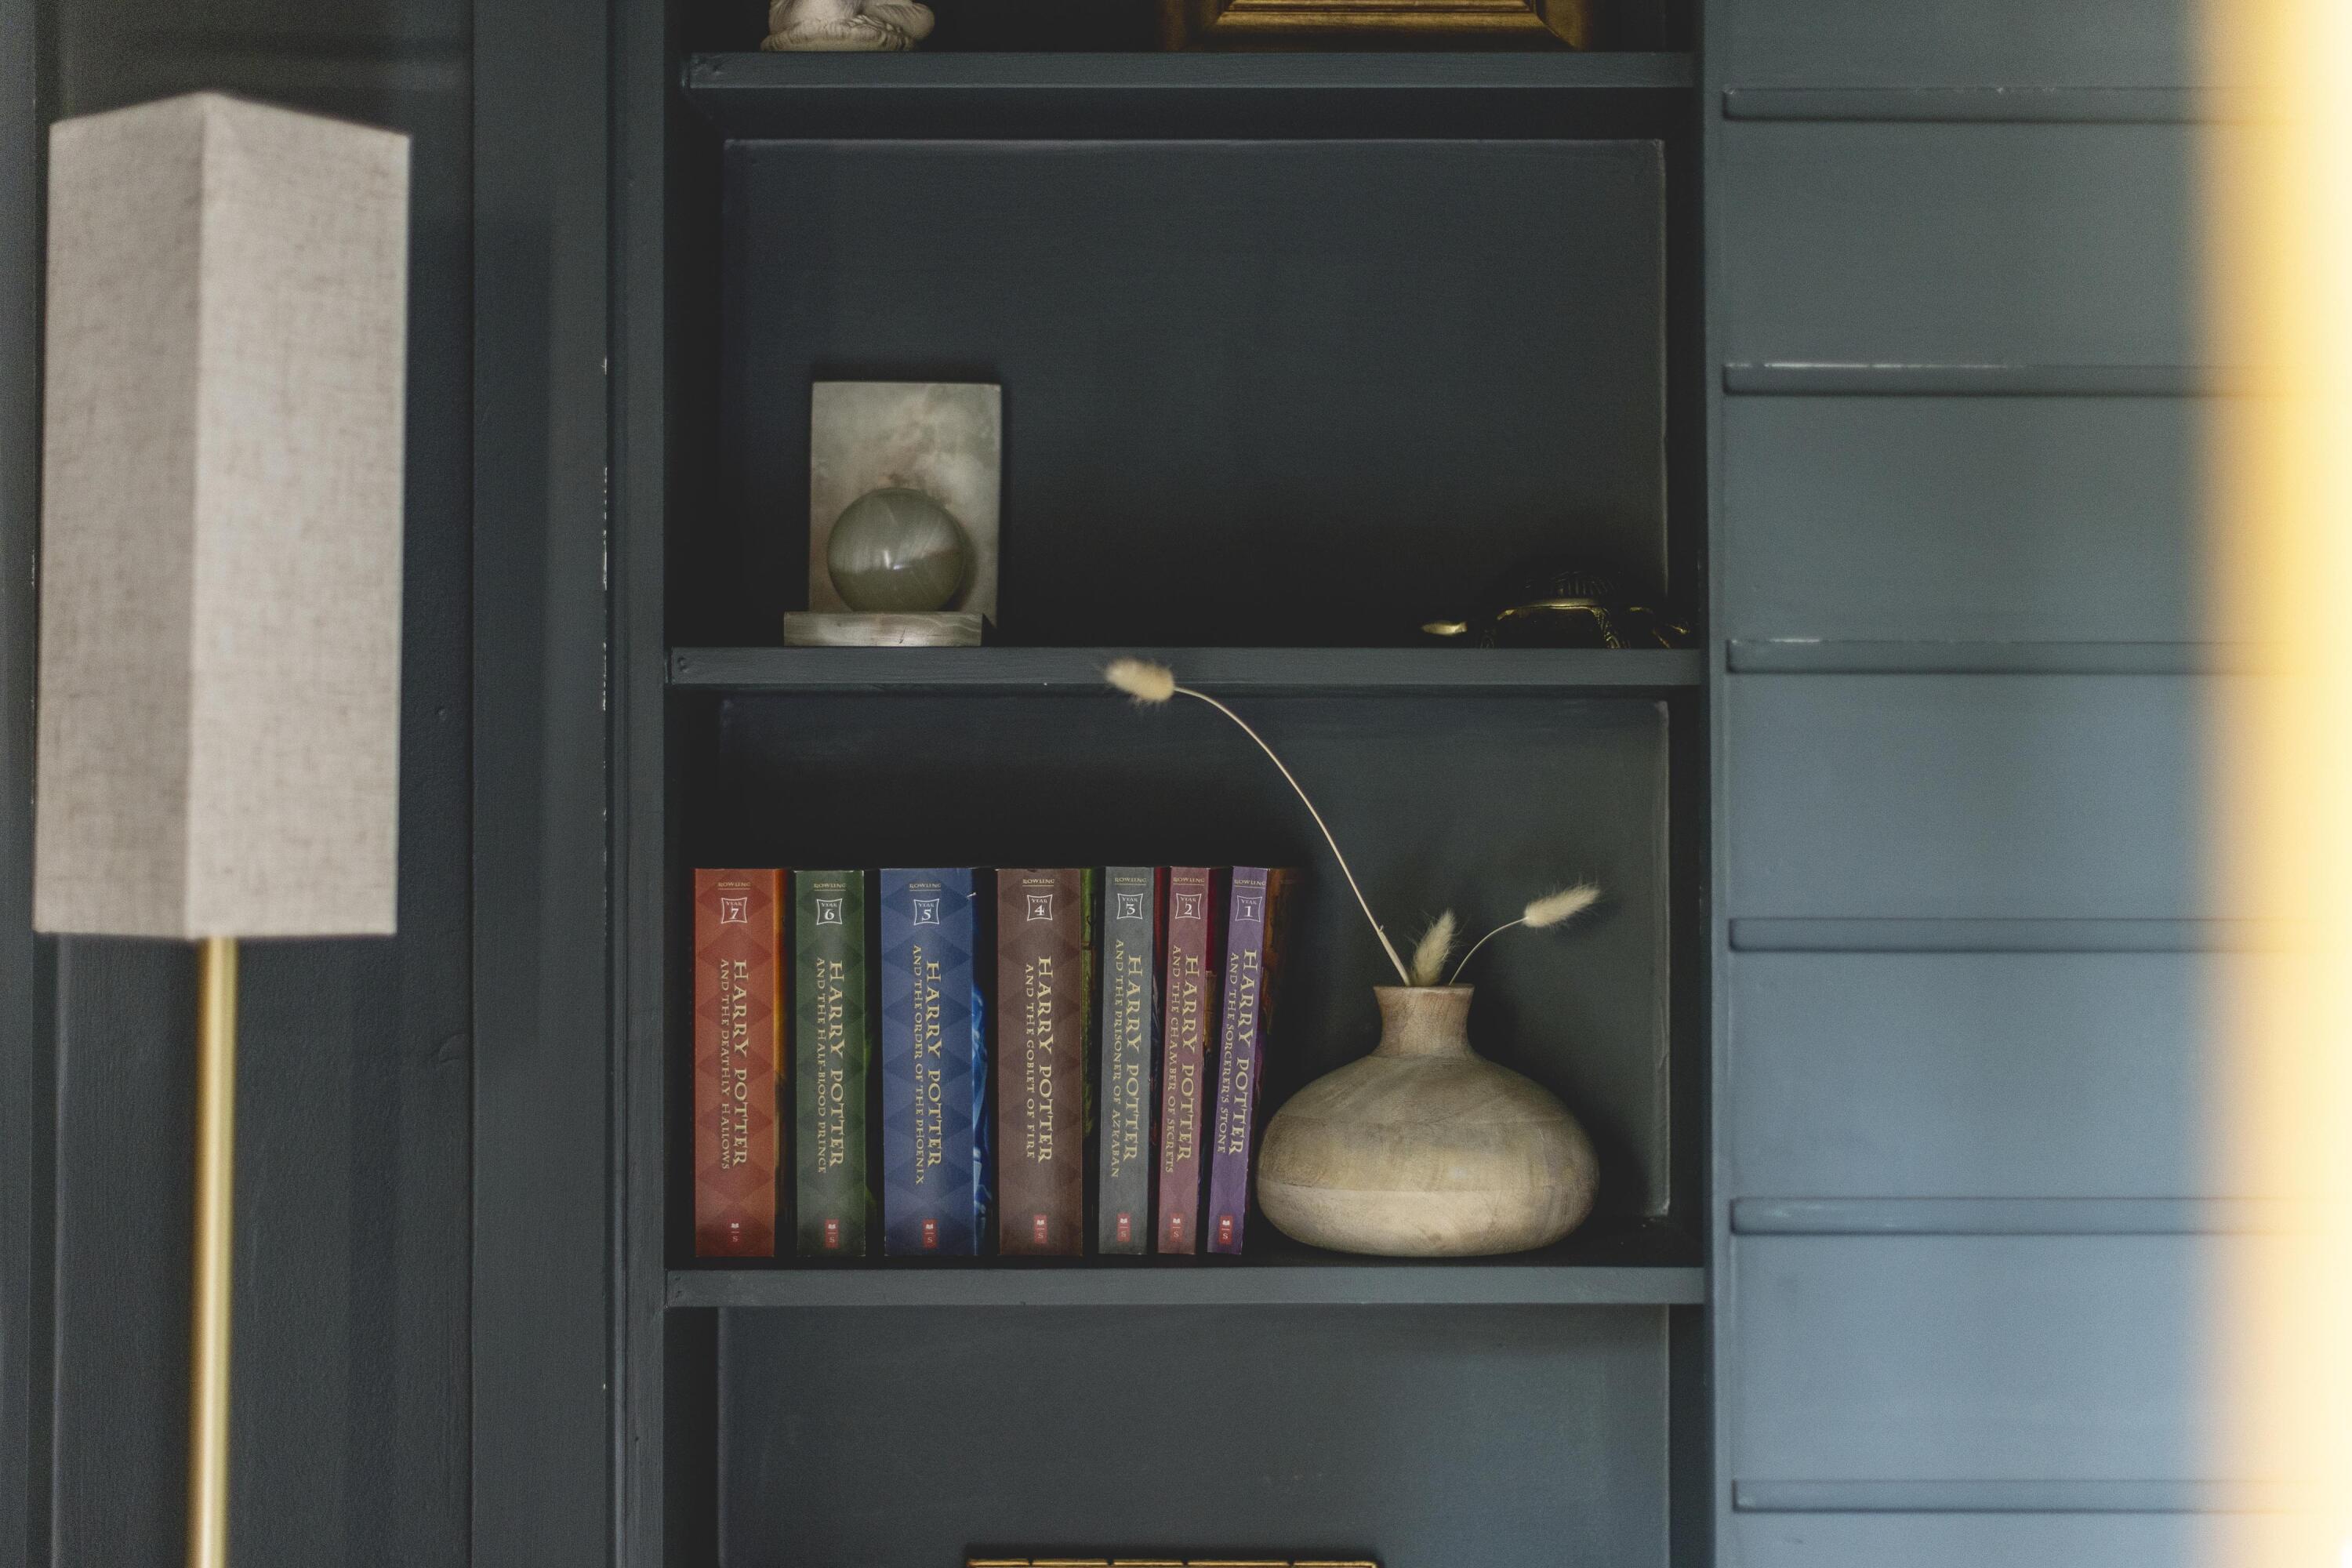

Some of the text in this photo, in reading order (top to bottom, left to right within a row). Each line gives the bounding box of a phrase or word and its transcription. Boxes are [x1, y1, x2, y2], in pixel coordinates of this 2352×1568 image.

[730, 908, 739, 920] 7
[825, 908, 834, 920] 6
[921, 908, 931, 920] 5
[1025, 964, 1034, 996] AND
[1034, 905, 1045, 916] 4
[1126, 903, 1135, 916] 3
[1184, 903, 1192, 915] 2
[1244, 906, 1252, 917] 1
[720, 959, 730, 1169] AND THE DEATHLY HALLOWS
[732, 960, 749, 1167] HARRY POTTER
[817, 956, 826, 1173] AND THE HALF-BLOOD PRINCE
[829, 961, 845, 1167] HARRY POTTER
[913, 945, 924, 1185] AND THE ORDER OF THE PHOENIX
[926, 961, 942, 1167] HARRY POTTER
[1026, 1099, 1035, 1118] OF
[1026, 1125, 1035, 1158] FIRE
[1038, 956, 1053, 1163] HARRY POTTER
[1111, 940, 1124, 1178] AND THE PRISONER OF AZKABAN
[1123, 955, 1142, 1161] HARRY POTTER
[1165, 946, 1181, 1173] AND THE CHAMBER OF SECRETS
[1177, 955, 1199, 1161] HARRY POTTER
[1217, 953, 1239, 1154] AND THE SORCERER'S STONE
[1229, 949, 1258, 1156] HARRY POTTER
